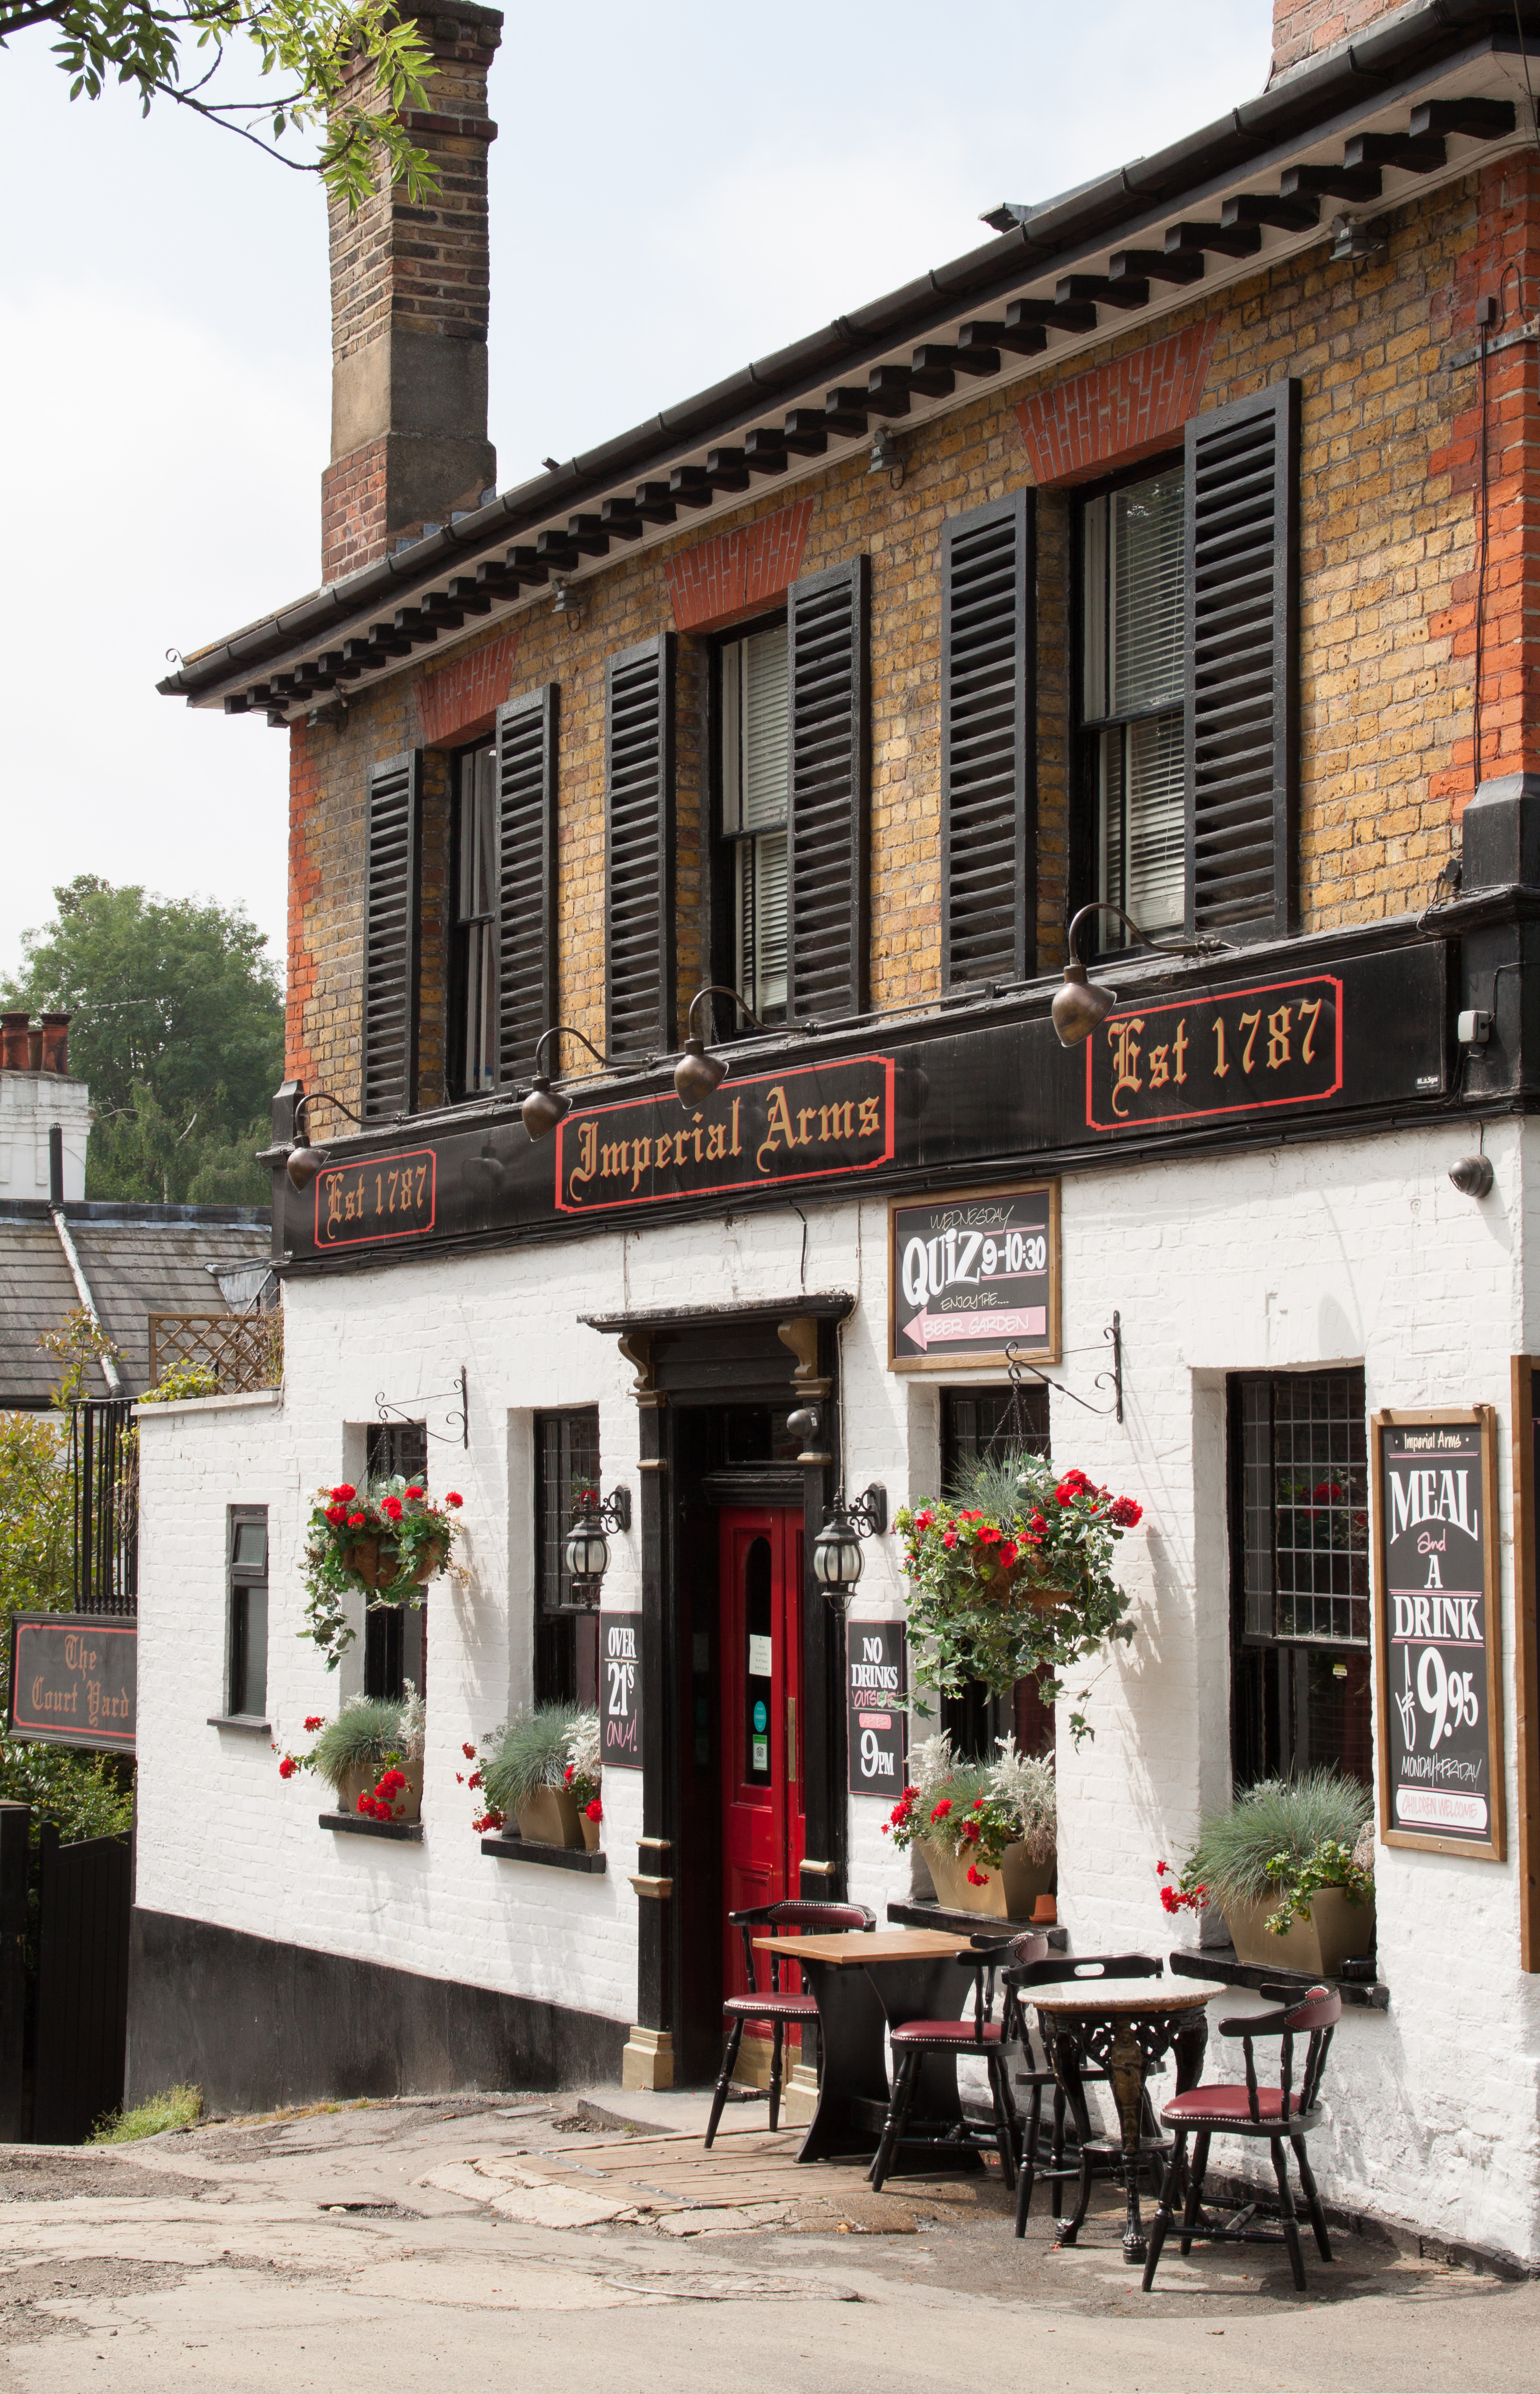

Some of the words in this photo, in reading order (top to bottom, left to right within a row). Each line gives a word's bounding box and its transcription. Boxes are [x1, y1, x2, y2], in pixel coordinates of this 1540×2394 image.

[1108, 1019, 1188, 1117] Est
[1213, 998, 1322, 1078] 1787
[569, 1096, 741, 1201] Imperial
[757, 1086, 880, 1172] Arms
[326, 1173, 365, 1239] Est
[375, 1164, 427, 1215] 1787
[930, 1205, 1014, 1232] WEDNESDAY
[940, 1294, 978, 1310] ENJOY
[922, 1318, 965, 1339] BEER
[969, 1314, 1029, 1336] GARDEN
[1404, 1432, 1435, 1452] Imperial
[1437, 1430, 1462, 1448] Arms
[1389, 1470, 1478, 1544] MEAL
[1424, 1554, 1443, 1588] A
[1393, 1596, 1483, 1640] DRINK
[64, 1634, 97, 1681] The
[608, 1627, 636, 1658] OVER
[862, 1636, 882, 1664] NO
[851, 1664, 898, 1690] DRINKS
[32, 1676, 77, 1713] Court
[87, 1680, 128, 1727] Yard
[607, 1709, 637, 1752] ONLY!
[862, 1715, 889, 1728] AFTER
[1401, 1755, 1435, 1788] MONDAY
[1440, 1758, 1482, 1791] FRIDAY
[1402, 1794, 1436, 1816] CHILDREN
[1438, 1798, 1478, 1820] WELCOME
